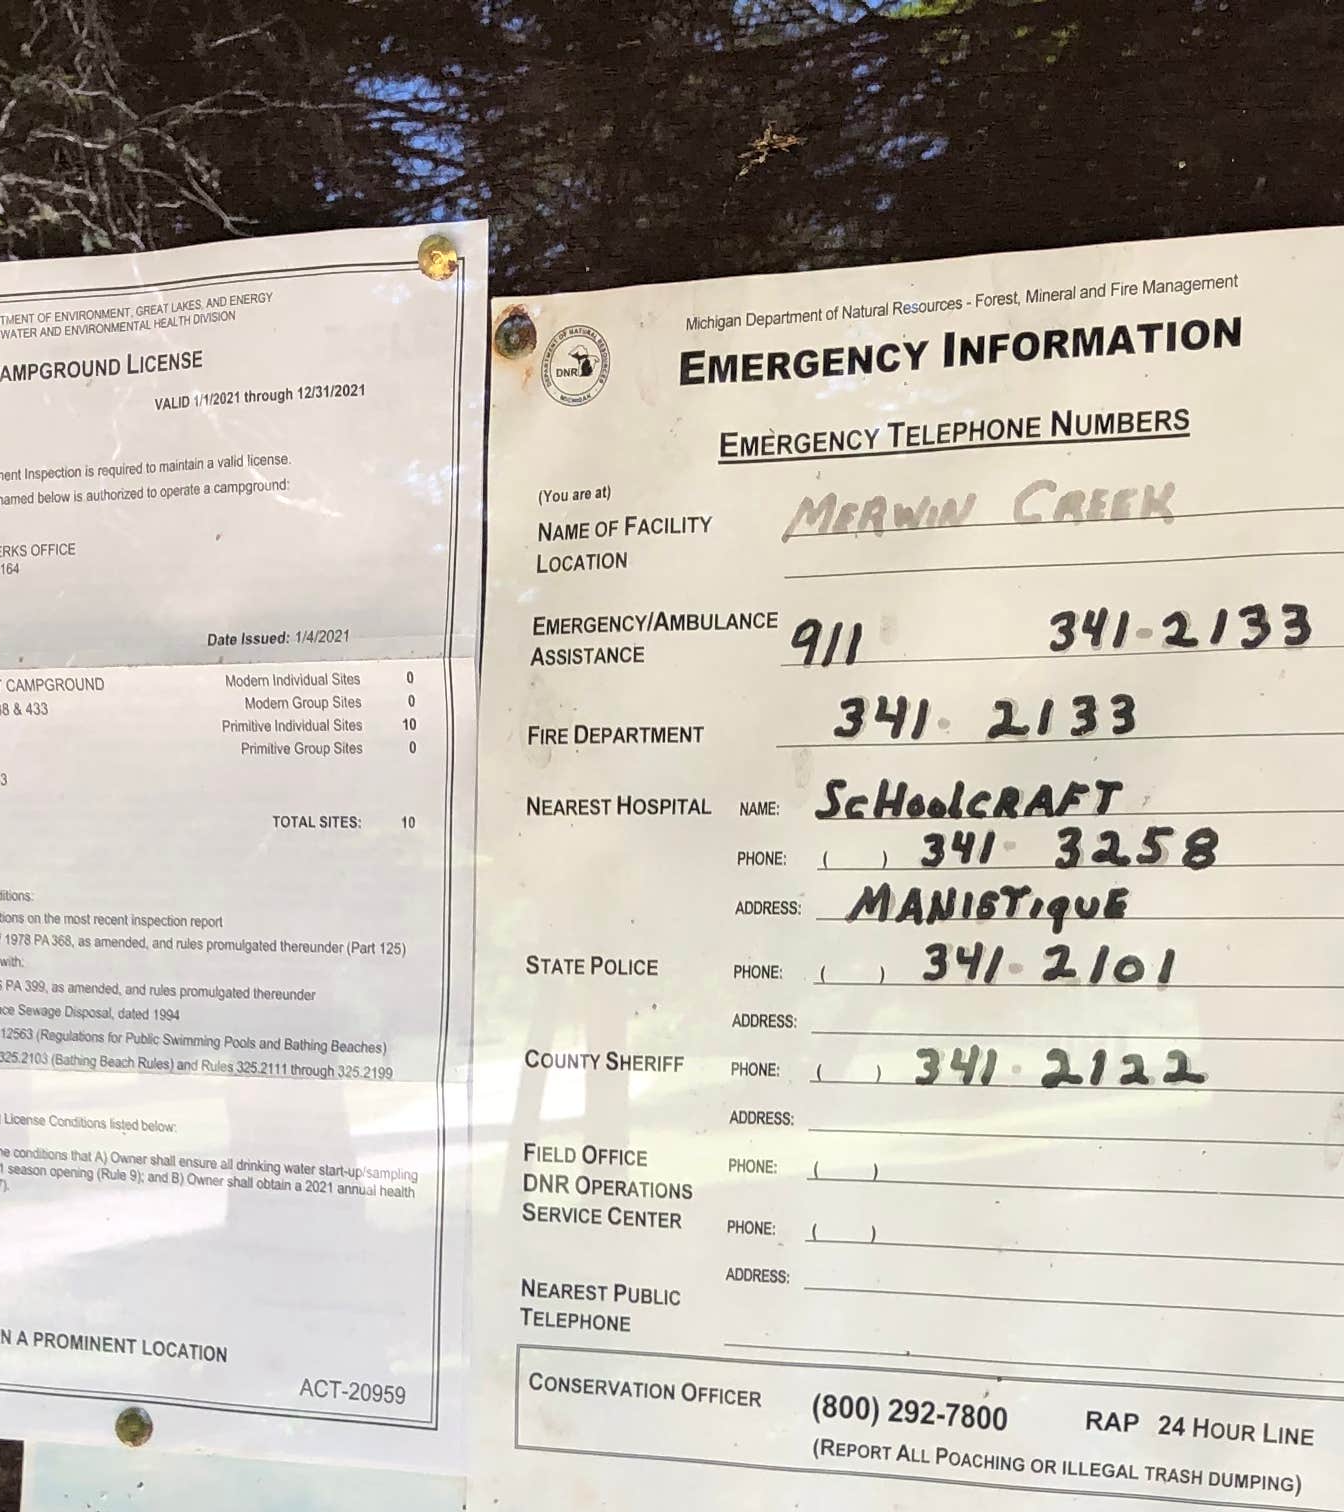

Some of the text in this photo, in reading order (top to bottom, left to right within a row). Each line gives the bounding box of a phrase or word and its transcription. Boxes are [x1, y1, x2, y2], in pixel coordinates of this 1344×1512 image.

[36, 311, 52, 324] OF
[54, 306, 134, 323] ENVIRONMENT,
[135, 302, 169, 317] GREAT
[171, 298, 204, 313] LAKES,
[205, 296, 228, 309] AND
[229, 291, 273, 307] ENERGY
[685, 314, 742, 332] Michigan
[745, 308, 823, 329] Department
[825, 305, 840, 321] of
[841, 301, 889, 320] Natural
[892, 298, 963, 316] Resources
[975, 290, 1021, 308] Forest,
[1025, 285, 1077, 304] Mineral
[1079, 282, 1107, 300] and
[1110, 281, 1139, 297] Fire
[1142, 273, 1239, 296] Management
[127, 349, 203, 375] LICENSE
[679, 316, 1242, 386] EMERGENCY INFORMATION
[556, 368, 578, 377] DNR
[154, 383, 365, 411] VALID 1/1/2021 through 12/31/2021
[719, 408, 1190, 457] EMERGENCY TELEPHONE NUMBERS
[538, 484, 612, 507] (You are at)
[538, 515, 713, 542] NAME OF FACILITY
[30, 542, 76, 557] OFFICE
[0, 562, 20, 576] 164
[536, 551, 628, 574] LOCATION
[532, 611, 779, 636] EMERGENCY/AMBULANCE
[207, 628, 350, 647] Date Issued: 1/4/2021
[791, 619, 862, 667] 911
[529, 646, 645, 667] ASSISTANCE
[5, 676, 105, 693] CAMPGROUND
[527, 724, 705, 746] FIRE DEPARTMENT
[526, 795, 712, 816] NEAREST HOSPITAL
[739, 800, 780, 817] NAME:
[272, 815, 362, 829] TOTAL SITES:
[401, 815, 416, 829] 10
[737, 850, 787, 866] PHONE:
[734, 900, 802, 916] ADDRESS:
[525, 954, 659, 976] STATE POLICE
[733, 964, 783, 980] PHONE:
[731, 1013, 797, 1029] ADDRESS:
[524, 1048, 685, 1073] COUNTY SHERIFF
[731, 1061, 780, 1077] PHONE:
[729, 1109, 794, 1126] ADDRESS:
[523, 1142, 648, 1167] FIELD OFFICE
[728, 1157, 778, 1175] PHONE:
[523, 1172, 693, 1200] DNR OPERATIONS
[522, 1202, 682, 1230] SERVICE CENTER
[727, 1219, 776, 1236] PHONE:
[725, 1267, 790, 1284] ADDRESS:
[521, 1278, 681, 1306] NEAREST PUBLIC
[519, 1307, 631, 1333] TELEPHONE
[16, 1330, 29, 1347] A
[33, 1331, 138, 1355] PROMINENT
[142, 1339, 228, 1363] LOCATION
[299, 1377, 406, 1405] ACT-20959
[528, 1372, 762, 1408] CONSERVATION OFFICER
[812, 1392, 1008, 1432] (800) 292-7800
[1085, 1410, 1315, 1447] RAP 24 HOUR LINE
[812, 1438, 1302, 1498] (REPORT ALL POACHING OR ILLEGAL TRASH DUMPING)
